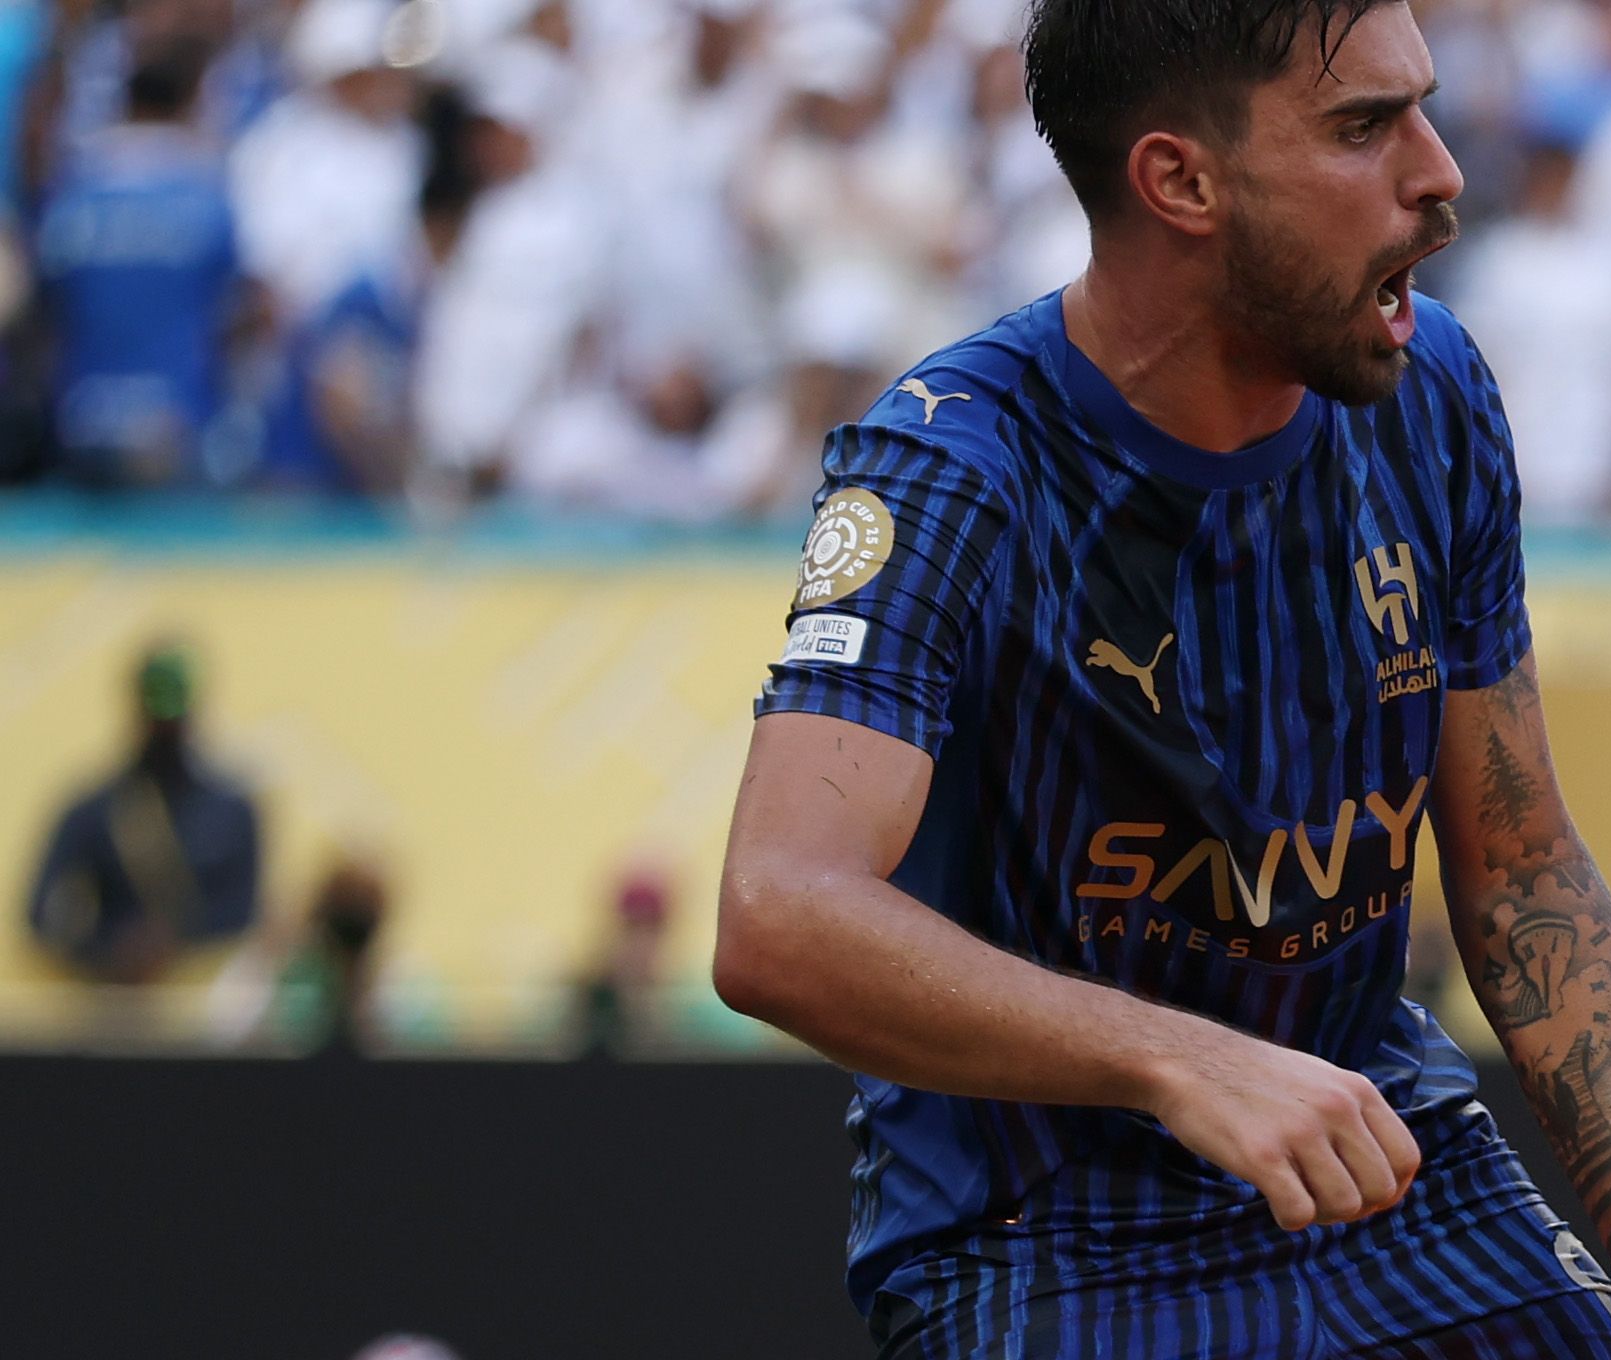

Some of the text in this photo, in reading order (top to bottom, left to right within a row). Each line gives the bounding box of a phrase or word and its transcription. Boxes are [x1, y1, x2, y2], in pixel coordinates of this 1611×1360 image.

[849, 501, 876, 523] CUP
[865, 526, 879, 546] 25
[843, 550, 875, 577] USA
[800, 579, 834, 604] FIFA
[814, 620, 852, 636] UNITES
[818, 639, 845, 653] FIFA
[1076, 775, 1429, 928] SAVVY
[1079, 879, 1414, 959] GAMES GROUP
